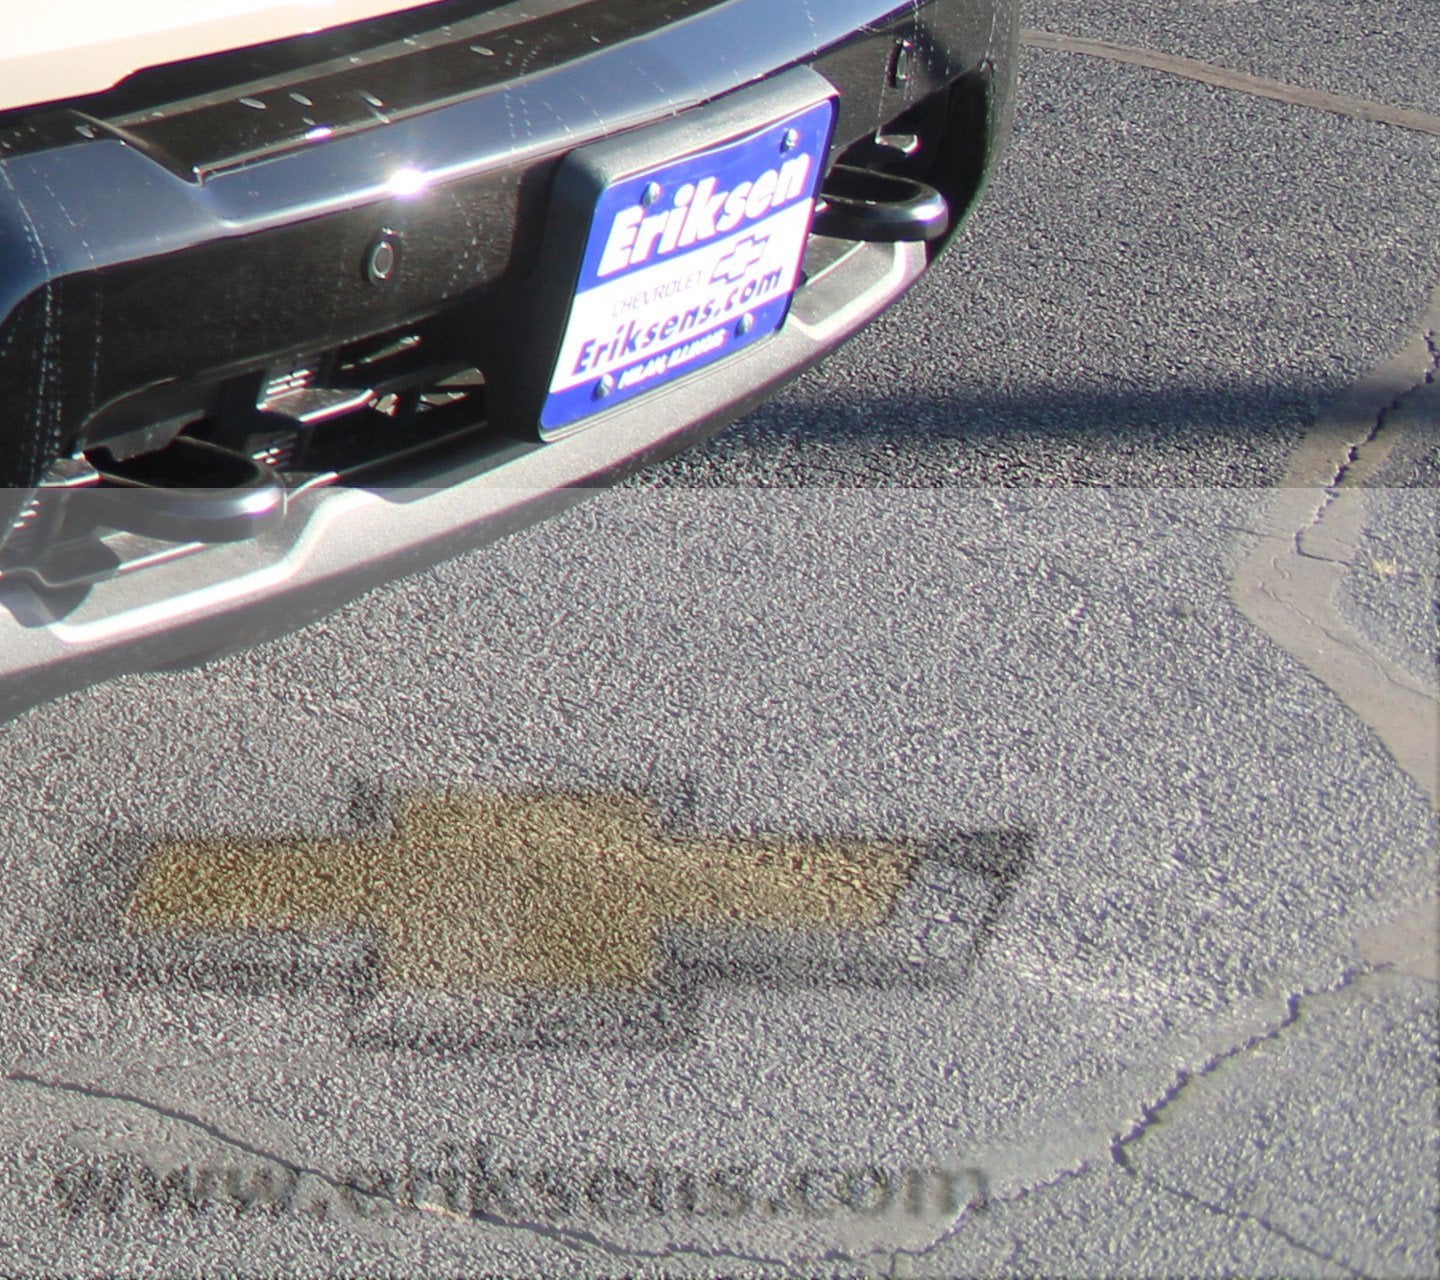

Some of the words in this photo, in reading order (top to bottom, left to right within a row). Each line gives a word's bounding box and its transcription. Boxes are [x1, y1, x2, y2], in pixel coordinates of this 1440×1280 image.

[597, 153, 813, 278] Eriksen
[571, 266, 784, 377] Eriksens.com
[612, 270, 703, 317] CHEVROLET
